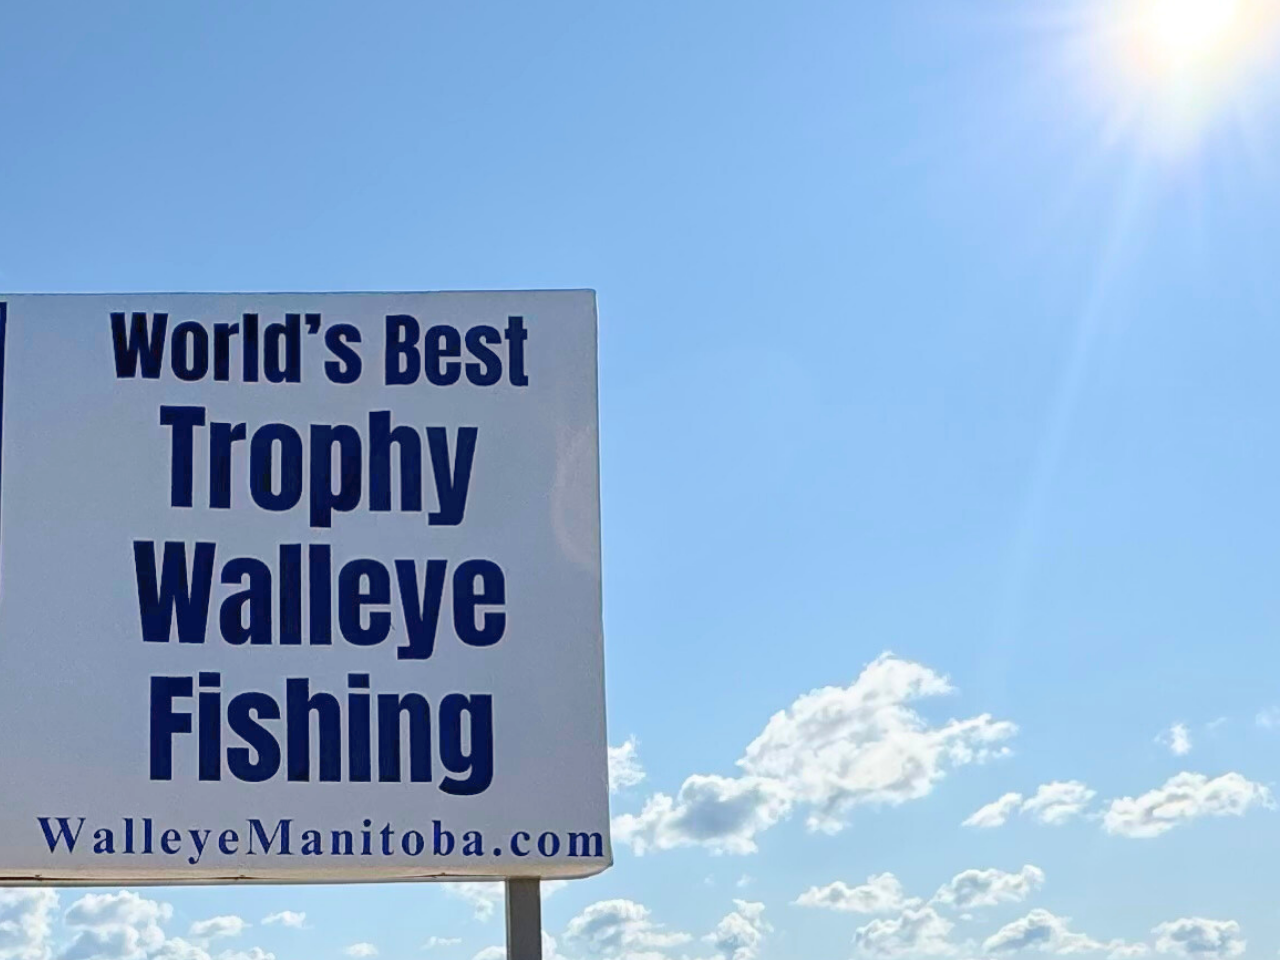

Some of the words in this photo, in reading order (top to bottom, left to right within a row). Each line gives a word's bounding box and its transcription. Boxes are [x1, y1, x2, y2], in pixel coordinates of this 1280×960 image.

[109, 311, 363, 386] World's
[384, 314, 530, 388] Best
[159, 404, 479, 528] Trophy
[132, 539, 507, 660] Walleye
[148, 671, 495, 796] Fishing
[36, 816, 606, 865] WalleyeManitoba.com
